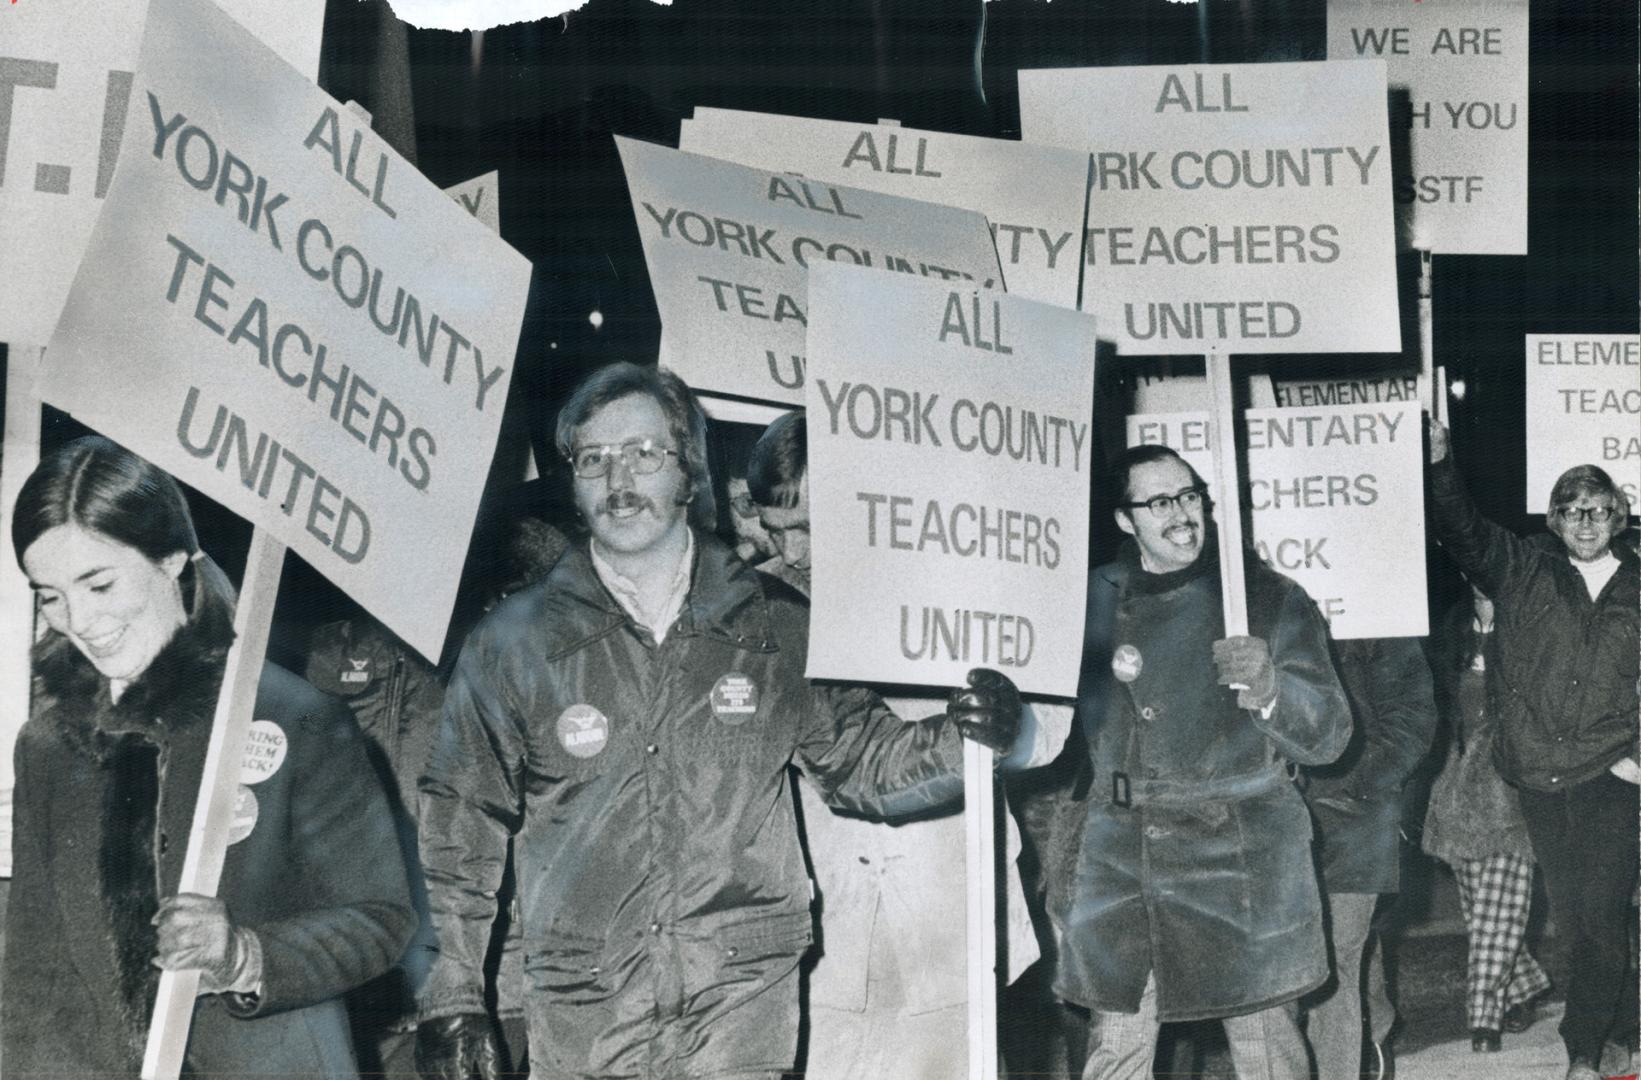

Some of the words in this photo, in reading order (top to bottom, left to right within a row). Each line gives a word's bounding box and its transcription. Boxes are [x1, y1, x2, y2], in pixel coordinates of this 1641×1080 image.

[1351, 27, 1410, 55] WE
[1431, 27, 1502, 55] ARE
[1155, 72, 1249, 113] ALL
[1444, 102, 1517, 130] YOU
[303, 106, 396, 219] ALL
[841, 131, 942, 178] ALL
[1090, 150, 1163, 190] RK
[1171, 145, 1381, 190] COUNTY
[768, 176, 863, 220] ALL
[146, 90, 290, 253] YORK
[297, 219, 505, 411] COUNTY
[641, 201, 785, 264] YORK
[991, 223, 1072, 269] TY
[1086, 224, 1340, 266] TEACHERS
[939, 291, 1013, 355] ALL
[1124, 301, 1302, 340] UNITED
[166, 233, 437, 492] TEACHERS
[1538, 341, 1640, 366] ELEME
[1558, 389, 1640, 414] TEAC
[816, 378, 942, 447] YORK
[950, 399, 1087, 472] COUNTY
[176, 385, 371, 565] UNITED
[857, 492, 1061, 570] TEACHERS
[899, 604, 1034, 668] UNITED
